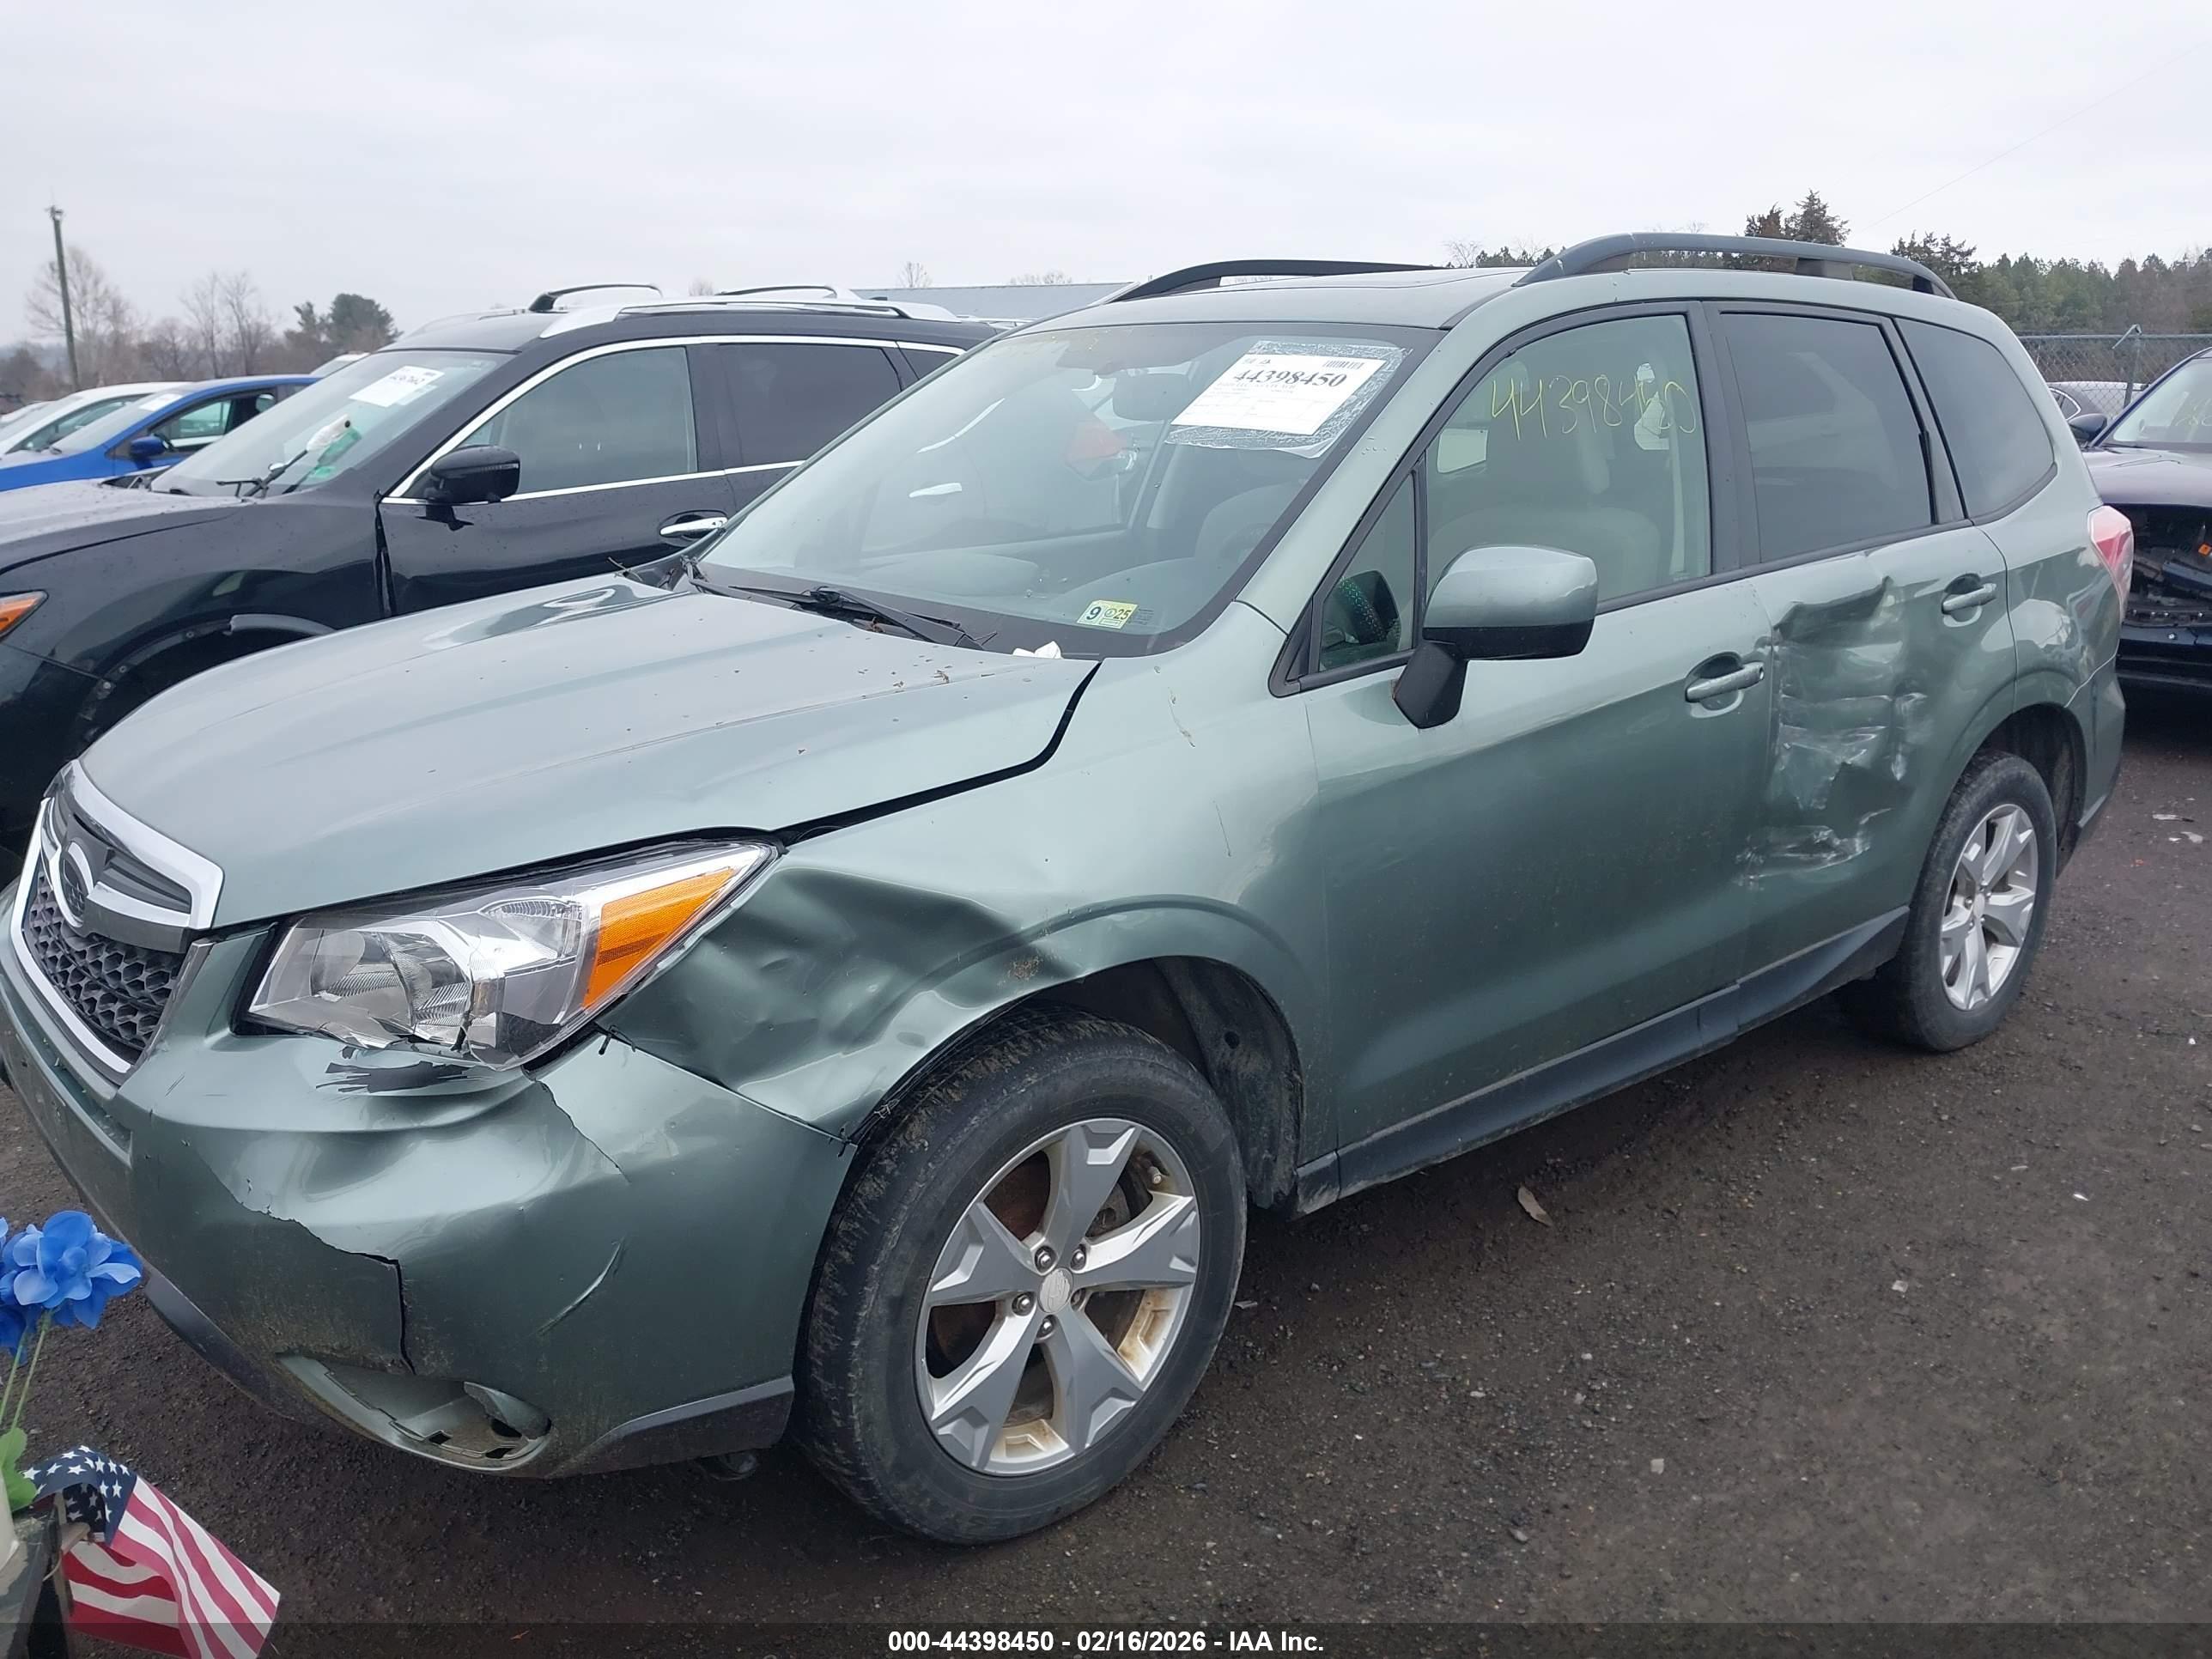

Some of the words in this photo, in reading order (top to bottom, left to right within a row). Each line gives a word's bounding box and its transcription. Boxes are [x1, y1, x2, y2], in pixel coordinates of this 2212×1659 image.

[1233, 368, 1347, 387] 44398450
[1086, 606, 1102, 620] 9
[1113, 609, 1132, 620] 25
